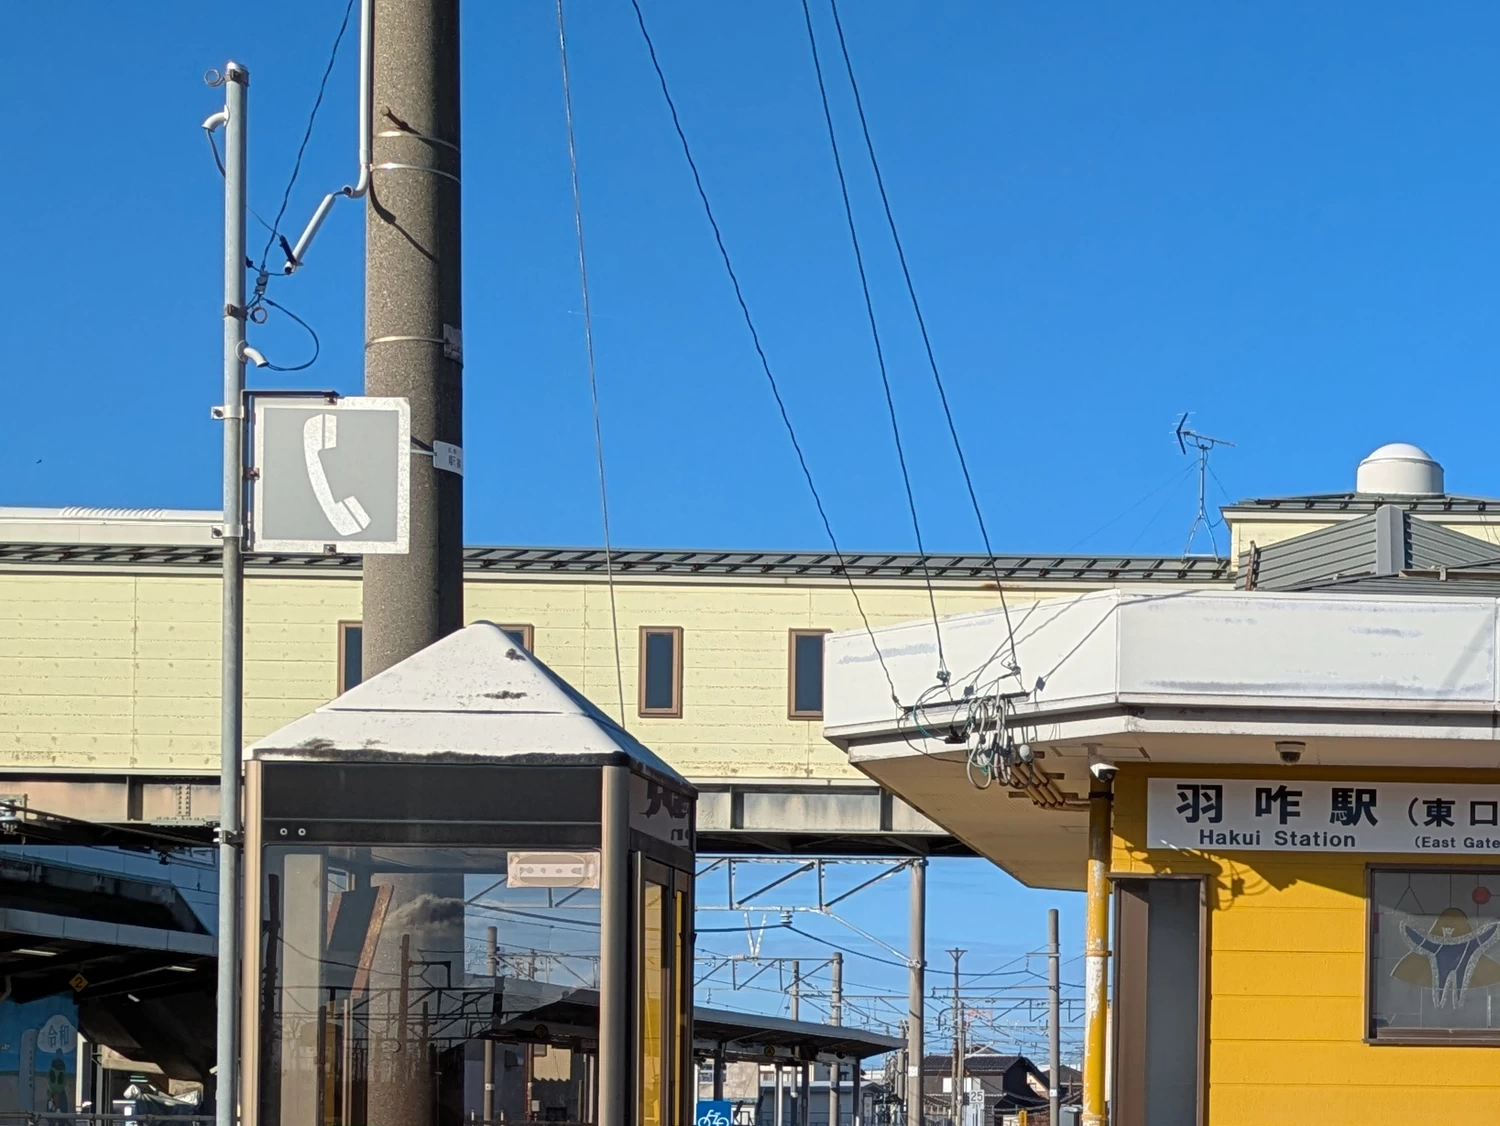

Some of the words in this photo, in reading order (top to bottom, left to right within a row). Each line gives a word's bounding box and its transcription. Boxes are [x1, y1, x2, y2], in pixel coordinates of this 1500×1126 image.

[1175, 783, 1379, 827] 羽咋駅
[1199, 828, 1262, 847] Hakui
[1273, 829, 1356, 849] Station
[1414, 834, 1457, 849] (East
[74, 976, 83, 989] 2
[47, 1024, 70, 1048] 令和
[969, 1090, 984, 1103] 25
